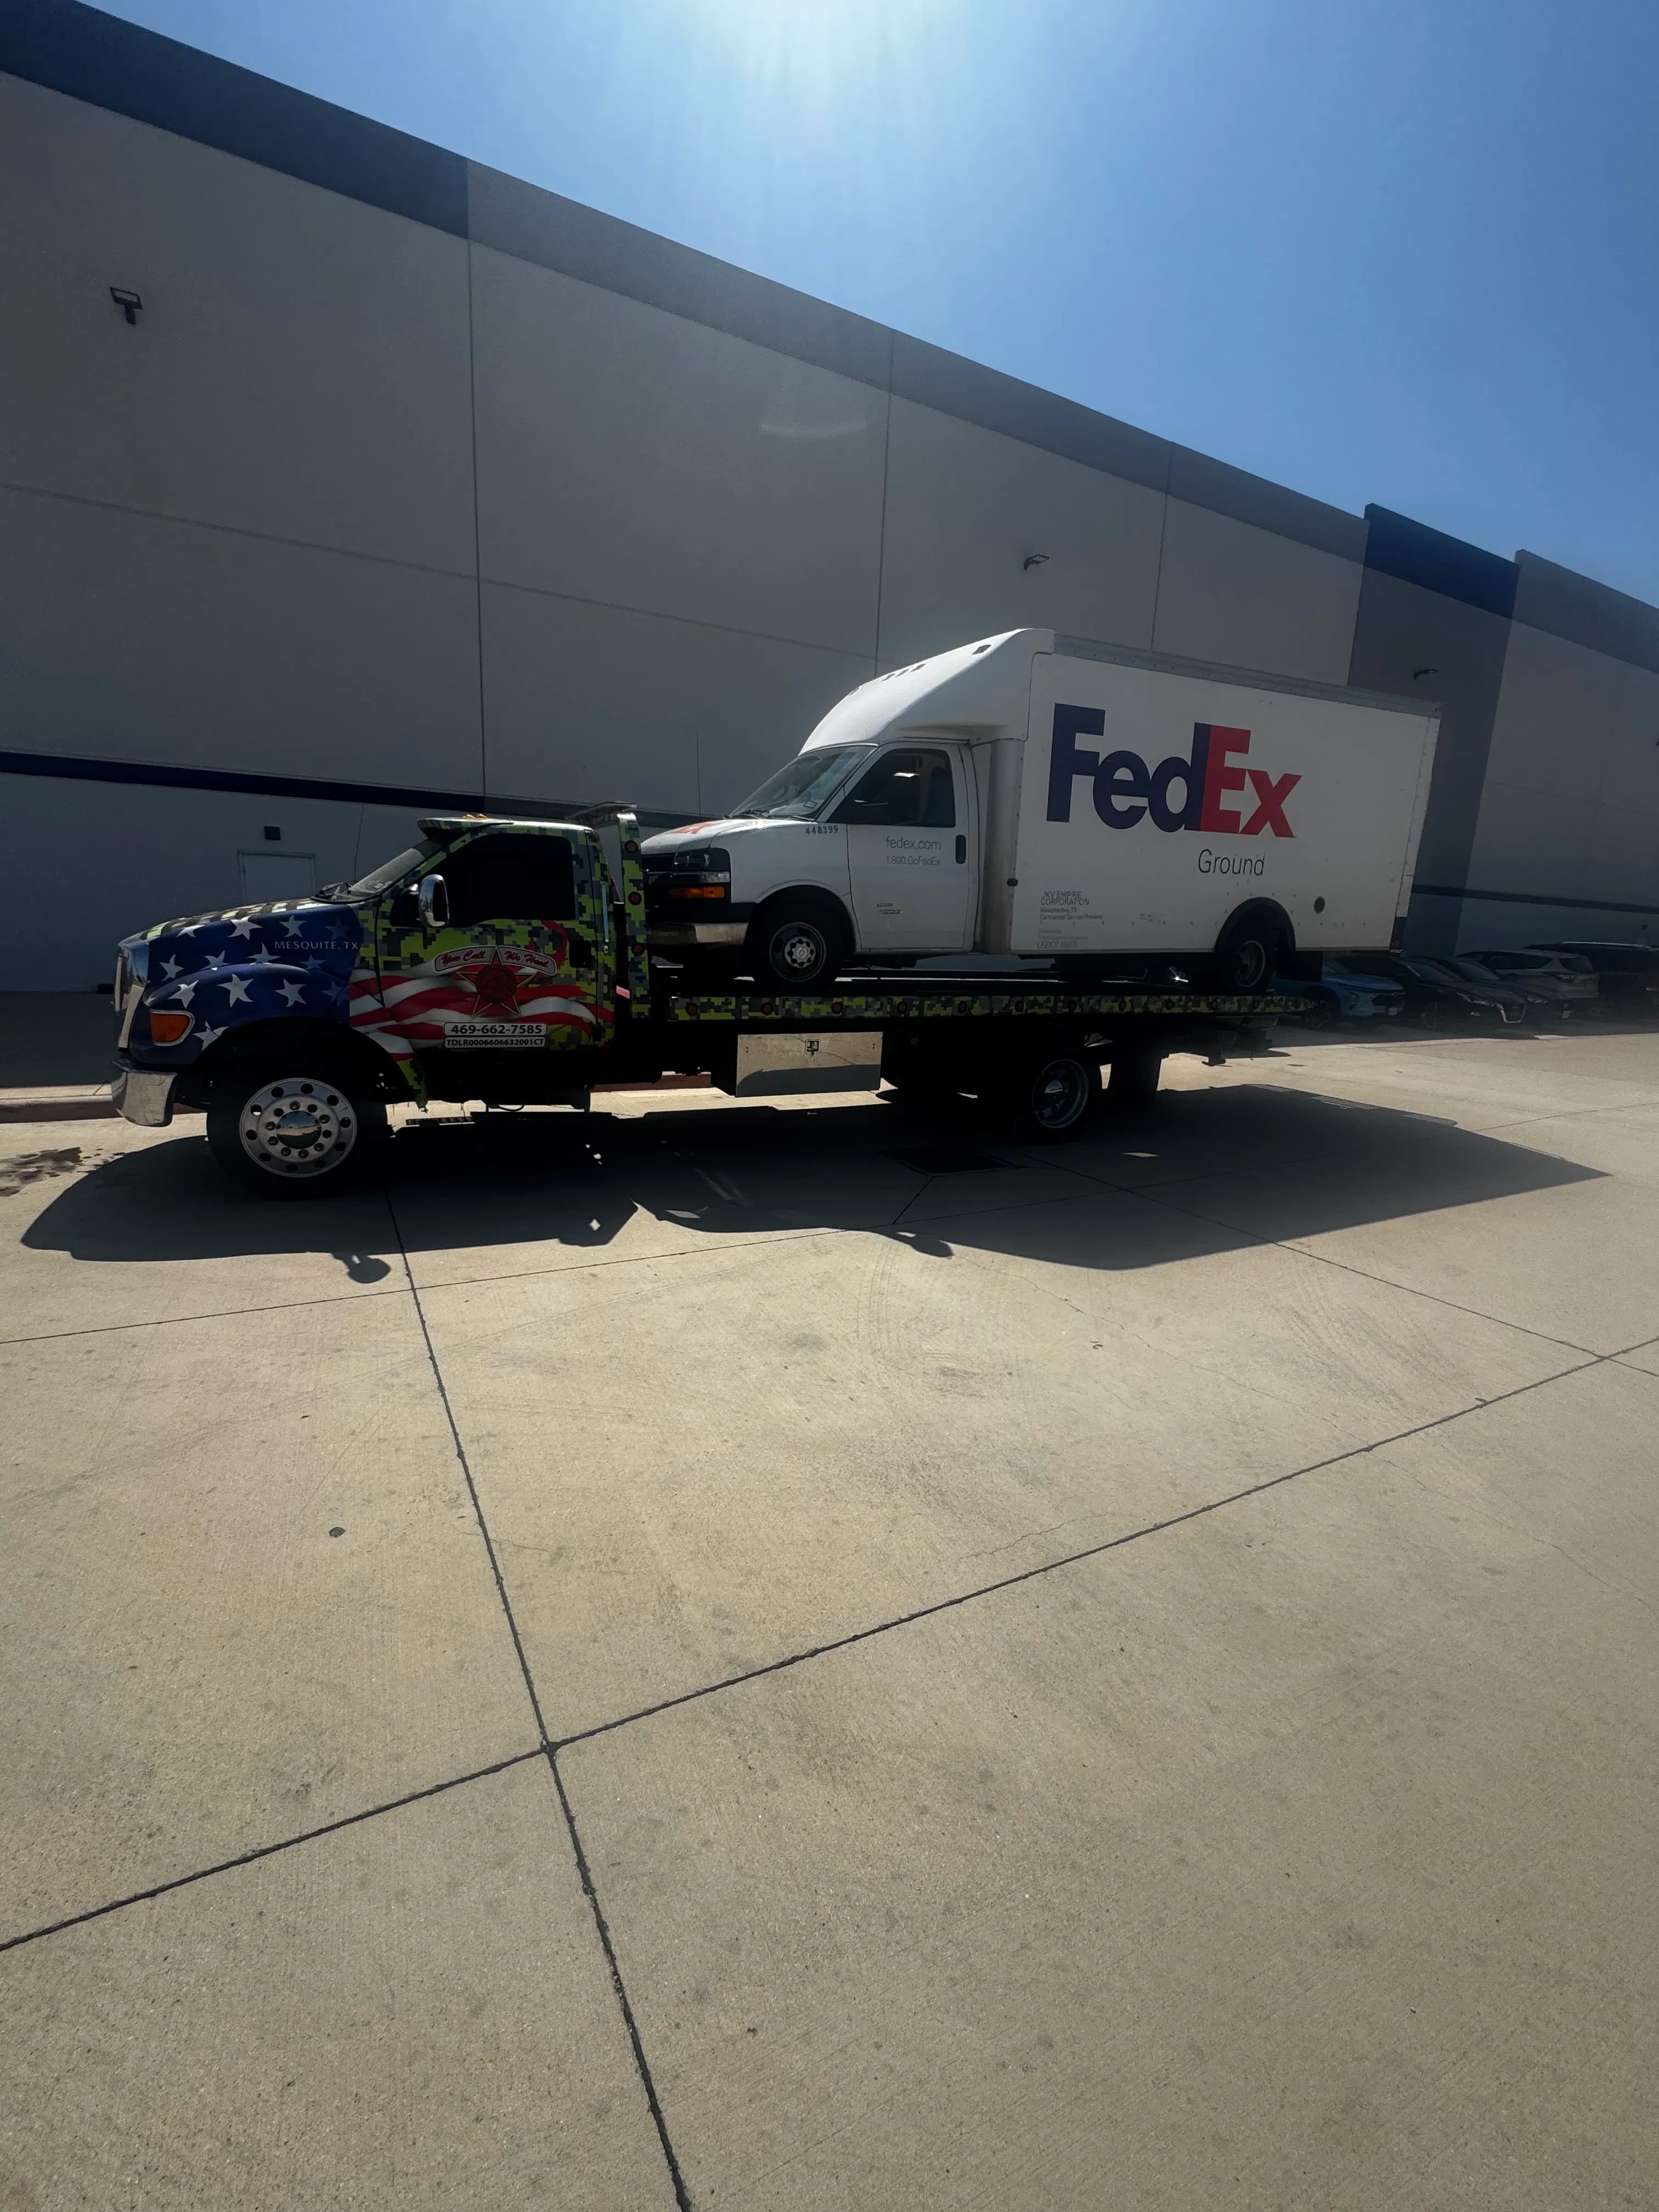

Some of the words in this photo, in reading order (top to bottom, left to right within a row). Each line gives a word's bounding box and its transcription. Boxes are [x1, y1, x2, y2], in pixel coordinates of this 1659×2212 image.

[1046, 703, 1302, 838] FedEx
[806, 825, 838, 834] 448399
[886, 836, 941, 850] fedex.com
[1198, 849, 1265, 876] Ground
[274, 940, 341, 950] MESQUITE,
[343, 941, 359, 950] TX
[450, 1025, 543, 1034] 469-662-7585
